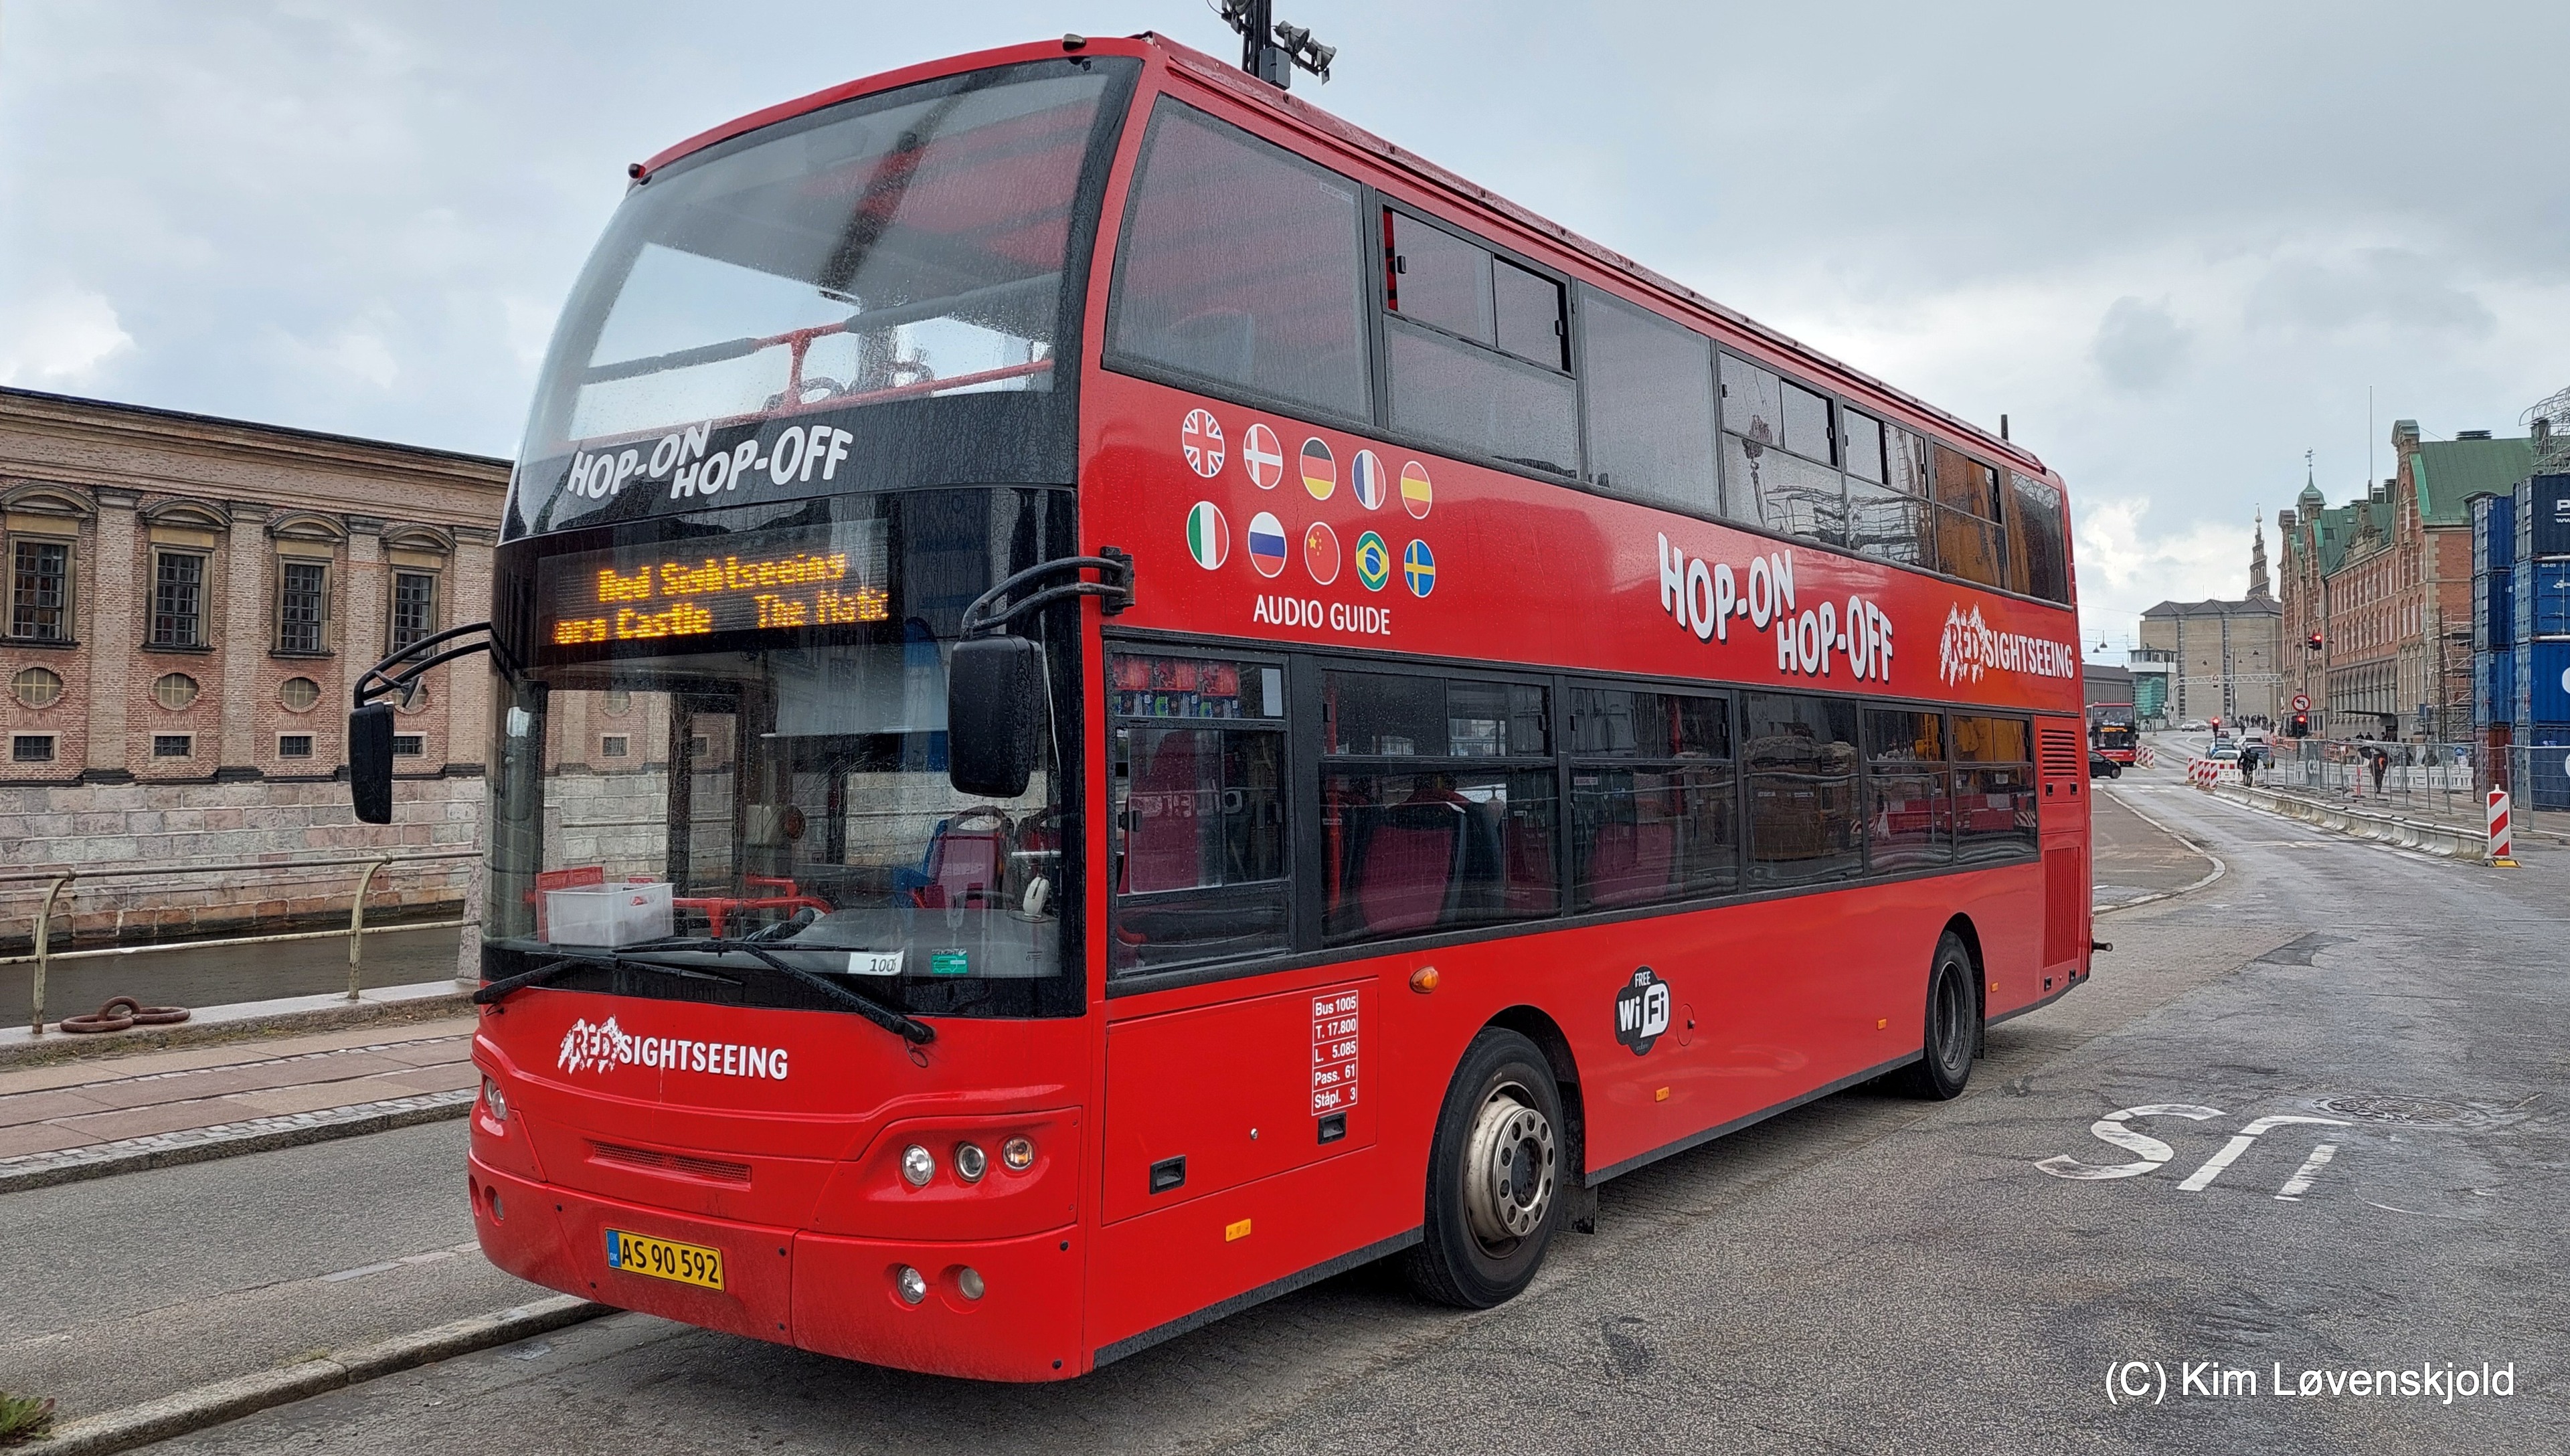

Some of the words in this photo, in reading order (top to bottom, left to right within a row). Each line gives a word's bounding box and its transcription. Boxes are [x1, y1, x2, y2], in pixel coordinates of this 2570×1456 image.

[567, 420, 712, 499] HOP-ON
[670, 425, 853, 499] HOP-OFF
[598, 566, 651, 602] Red
[616, 602, 712, 640] Castle
[754, 594, 806, 629] The
[1253, 594, 1323, 629] AUDIO
[1330, 603, 1391, 635] GUIDE
[1658, 531, 1795, 640] HOP-ON
[1777, 595, 1893, 682] HOP-OFF
[1985, 629, 2074, 679] SIGHTSEEING
[1634, 971, 1650, 988] FREE
[1315, 1002, 1334, 1016] Bus
[1335, 996, 1357, 1012] 1005
[1315, 1025, 1325, 1039] T.
[1327, 1018, 1357, 1036] 17.800
[619, 1034, 788, 1080] SIGHTSEEING
[1314, 1049, 1324, 1063] L.
[1332, 1040, 1356, 1059] 5.085
[1314, 1071, 1341, 1087] Pass.
[1345, 1063, 1355, 1079] 61
[1314, 1089, 1341, 1108] Ståpl.
[1350, 1087, 1356, 1101] 3
[610, 1253, 618, 1262] DK
[622, 1238, 647, 1269] AS
[651, 1244, 675, 1275] 90
[681, 1249, 718, 1284] 592
